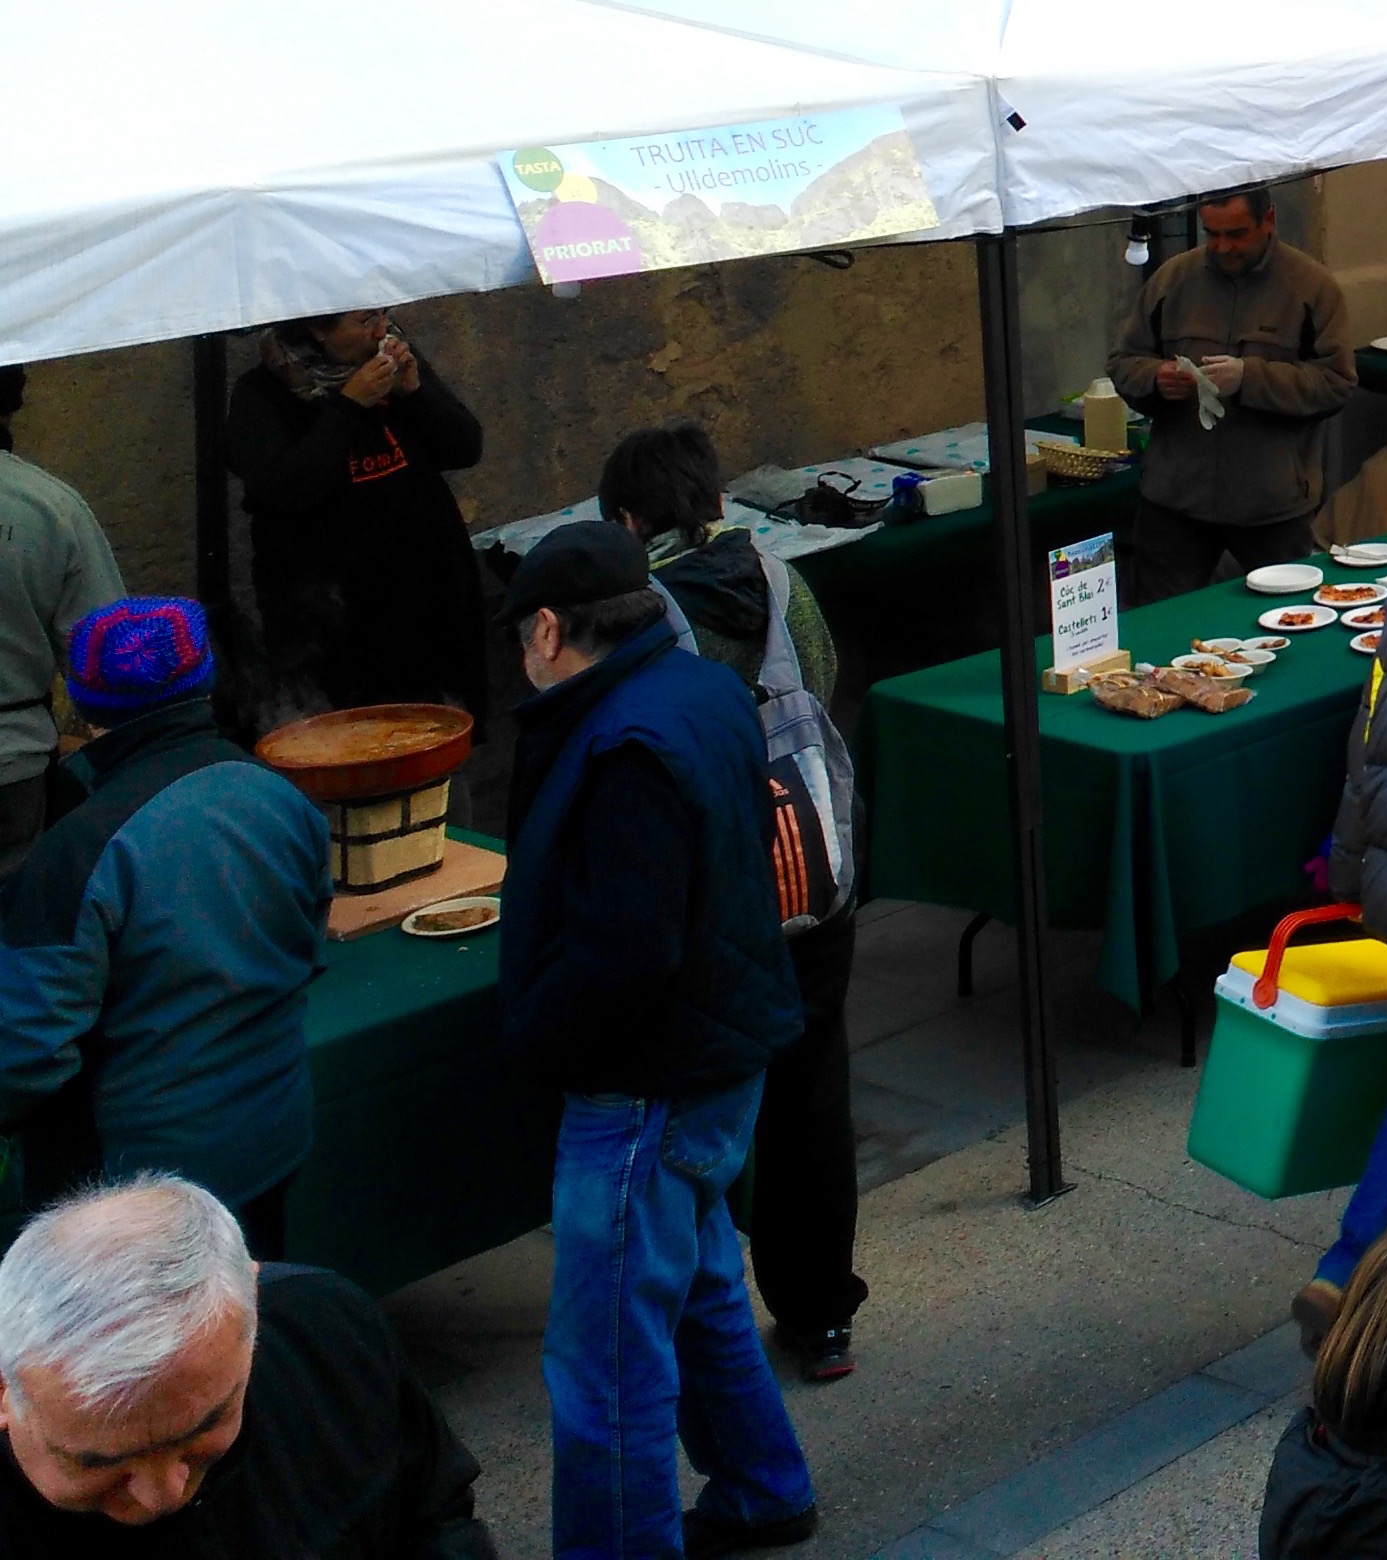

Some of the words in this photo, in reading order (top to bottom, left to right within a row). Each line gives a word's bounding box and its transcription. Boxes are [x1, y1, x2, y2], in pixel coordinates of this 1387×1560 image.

[630, 137, 729, 168] TRUITA
[731, 132, 767, 155] EN
[772, 124, 825, 149] SUC
[514, 161, 562, 176] TASTA
[667, 160, 811, 195] Ulldemolins
[543, 237, 631, 262] PRIORAT
